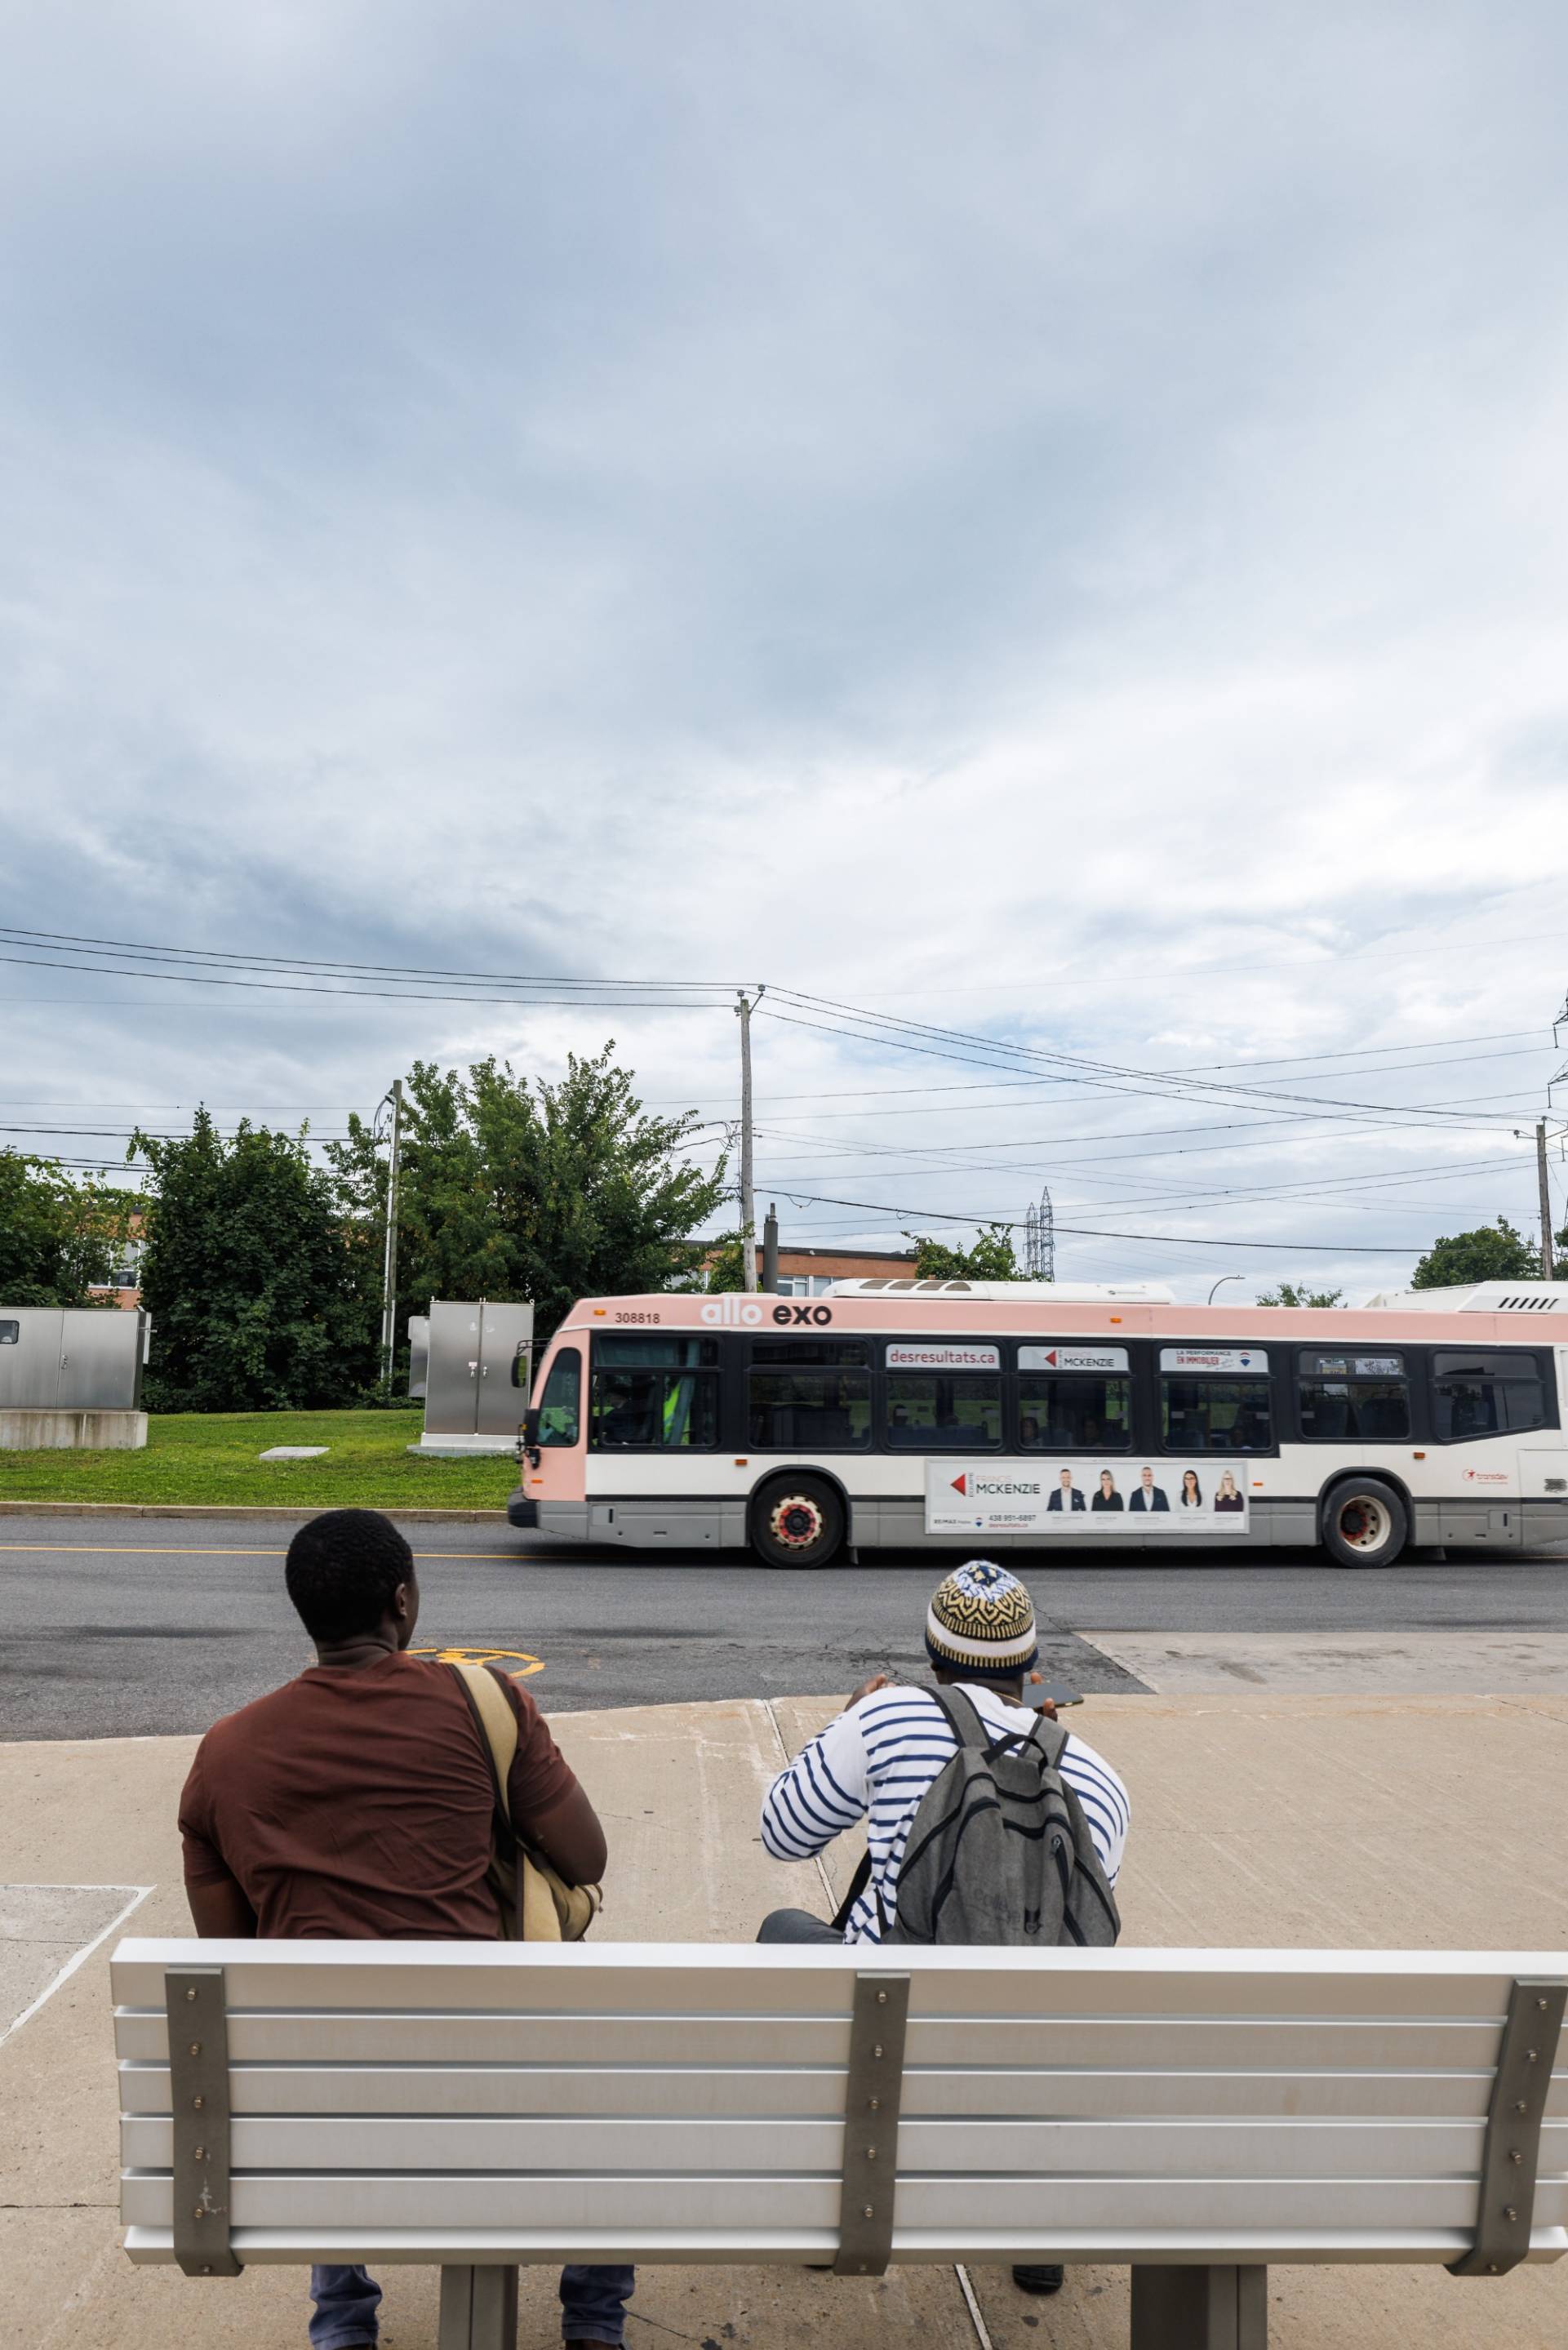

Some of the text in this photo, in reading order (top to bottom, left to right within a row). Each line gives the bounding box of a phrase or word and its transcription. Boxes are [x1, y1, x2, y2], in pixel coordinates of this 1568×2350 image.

[700, 1298, 833, 1326] allo exo
[615, 1313, 660, 1324] 308818
[890, 1349, 995, 1364] desresultats.ca
[1064, 1357, 1115, 1367] MCKENZIE
[976, 1483, 1041, 1495] MCKENZIE
